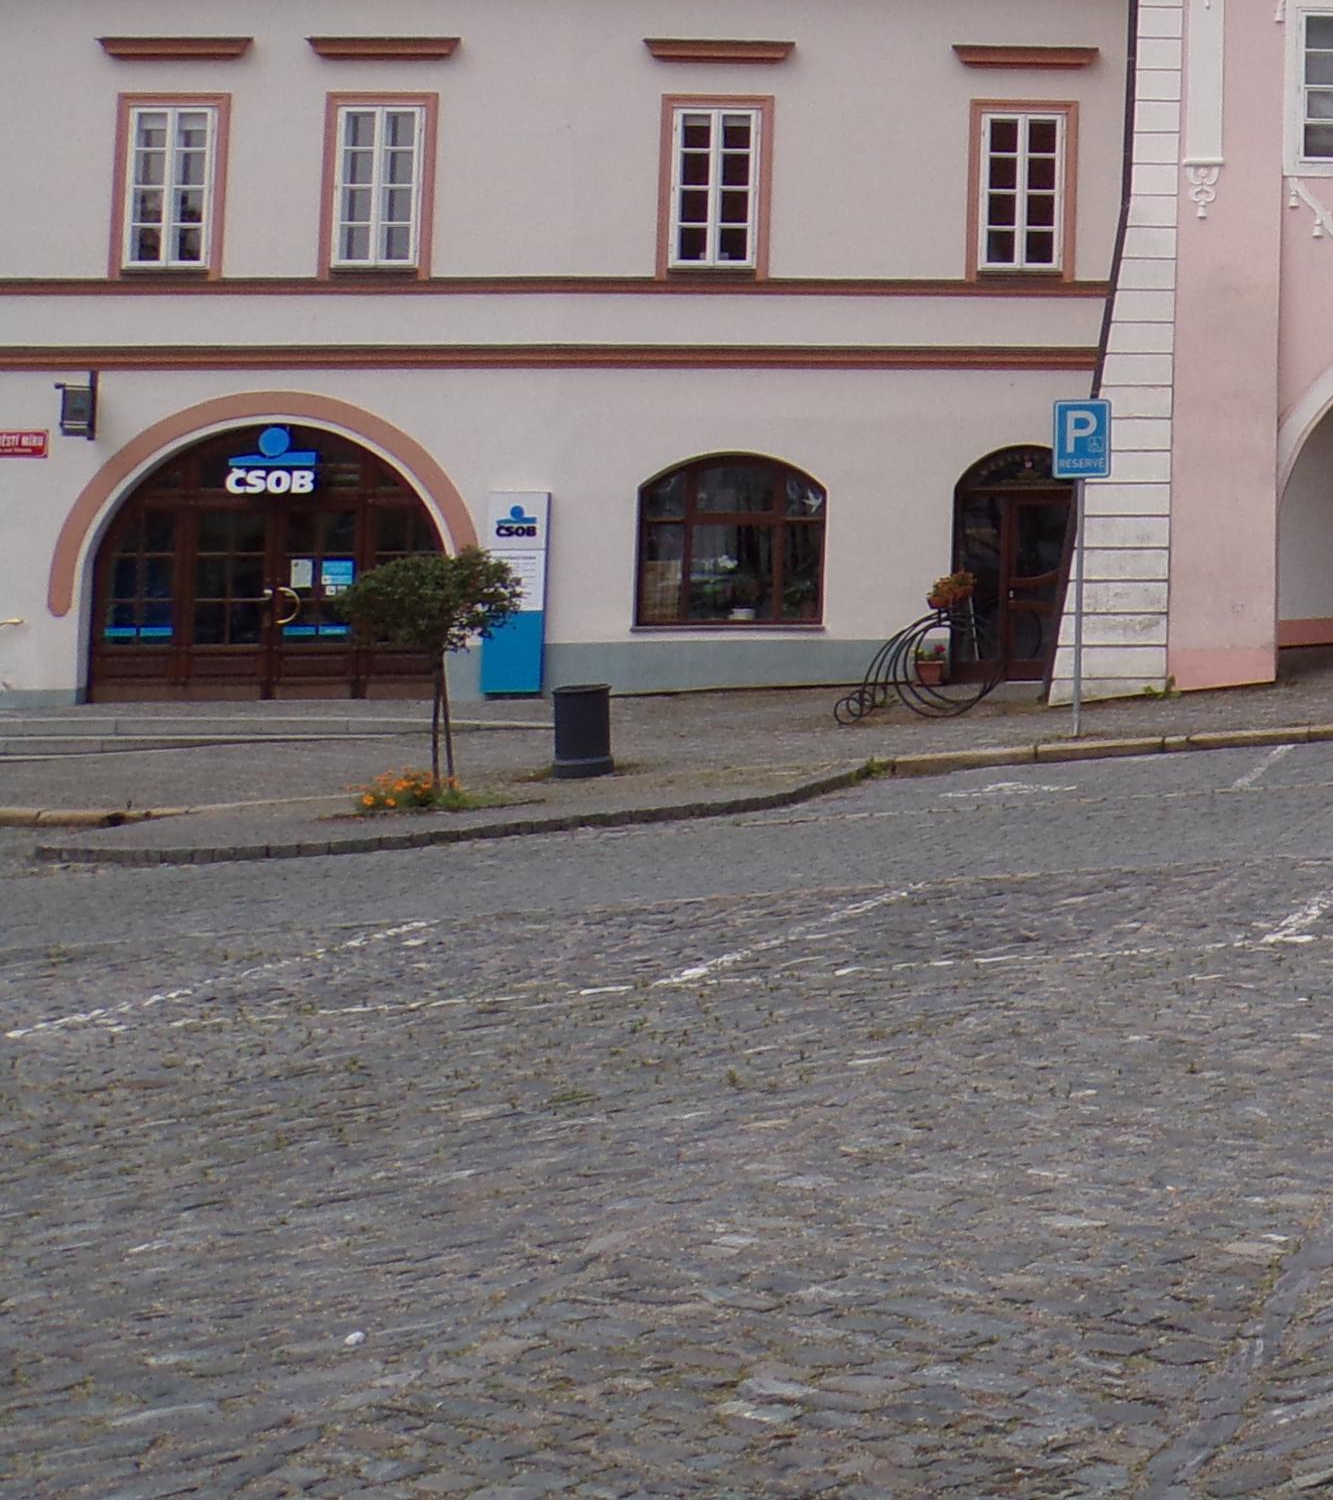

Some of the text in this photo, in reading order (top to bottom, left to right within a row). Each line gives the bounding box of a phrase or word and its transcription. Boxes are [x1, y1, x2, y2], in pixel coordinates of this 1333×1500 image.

[1066, 410, 1098, 453] P
[1058, 456, 1105, 469] RESERVÉ
[225, 467, 315, 494] ČSOB
[495, 524, 537, 537] ČSOB
